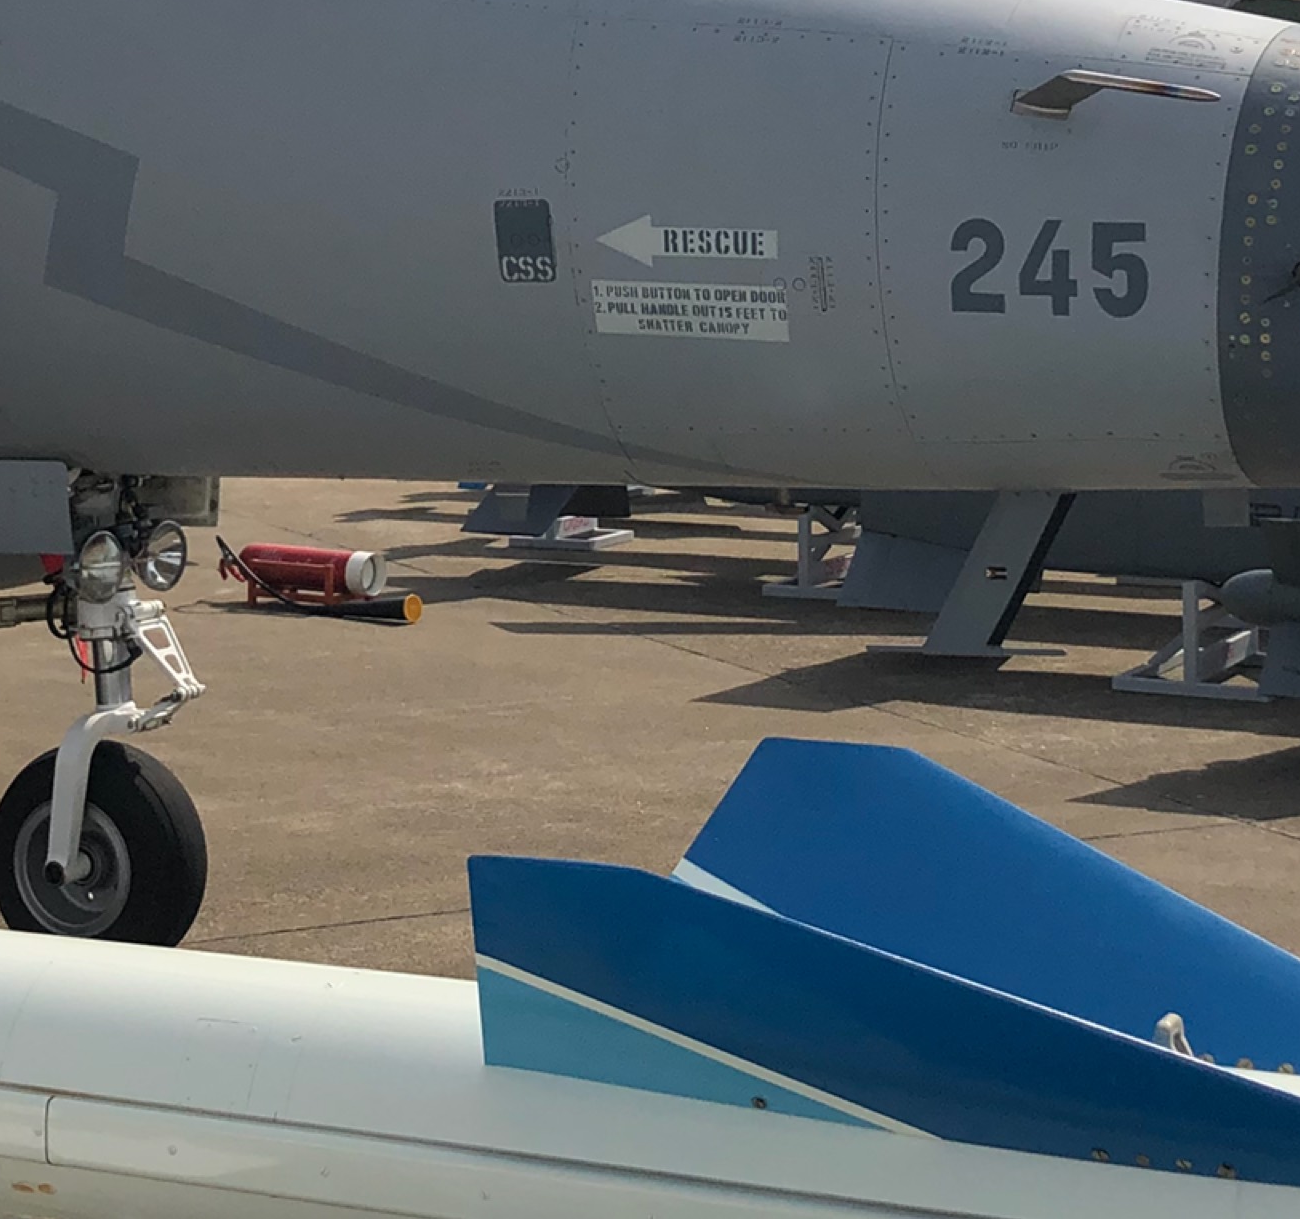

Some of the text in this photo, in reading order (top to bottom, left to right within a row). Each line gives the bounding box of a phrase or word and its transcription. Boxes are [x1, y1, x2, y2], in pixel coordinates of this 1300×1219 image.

[662, 229, 765, 256] RESCUE
[501, 256, 554, 281] CSS
[950, 217, 1150, 319] 245
[593, 285, 786, 304] 1. PUSH BUTTON TO OPEN DOOR
[608, 302, 638, 315] PULL
[641, 304, 689, 317] HANDLE
[692, 305, 716, 318] OUT
[736, 308, 765, 320] FEET
[770, 309, 787, 322] TO
[638, 319, 750, 335] SHATTER CANOPY
